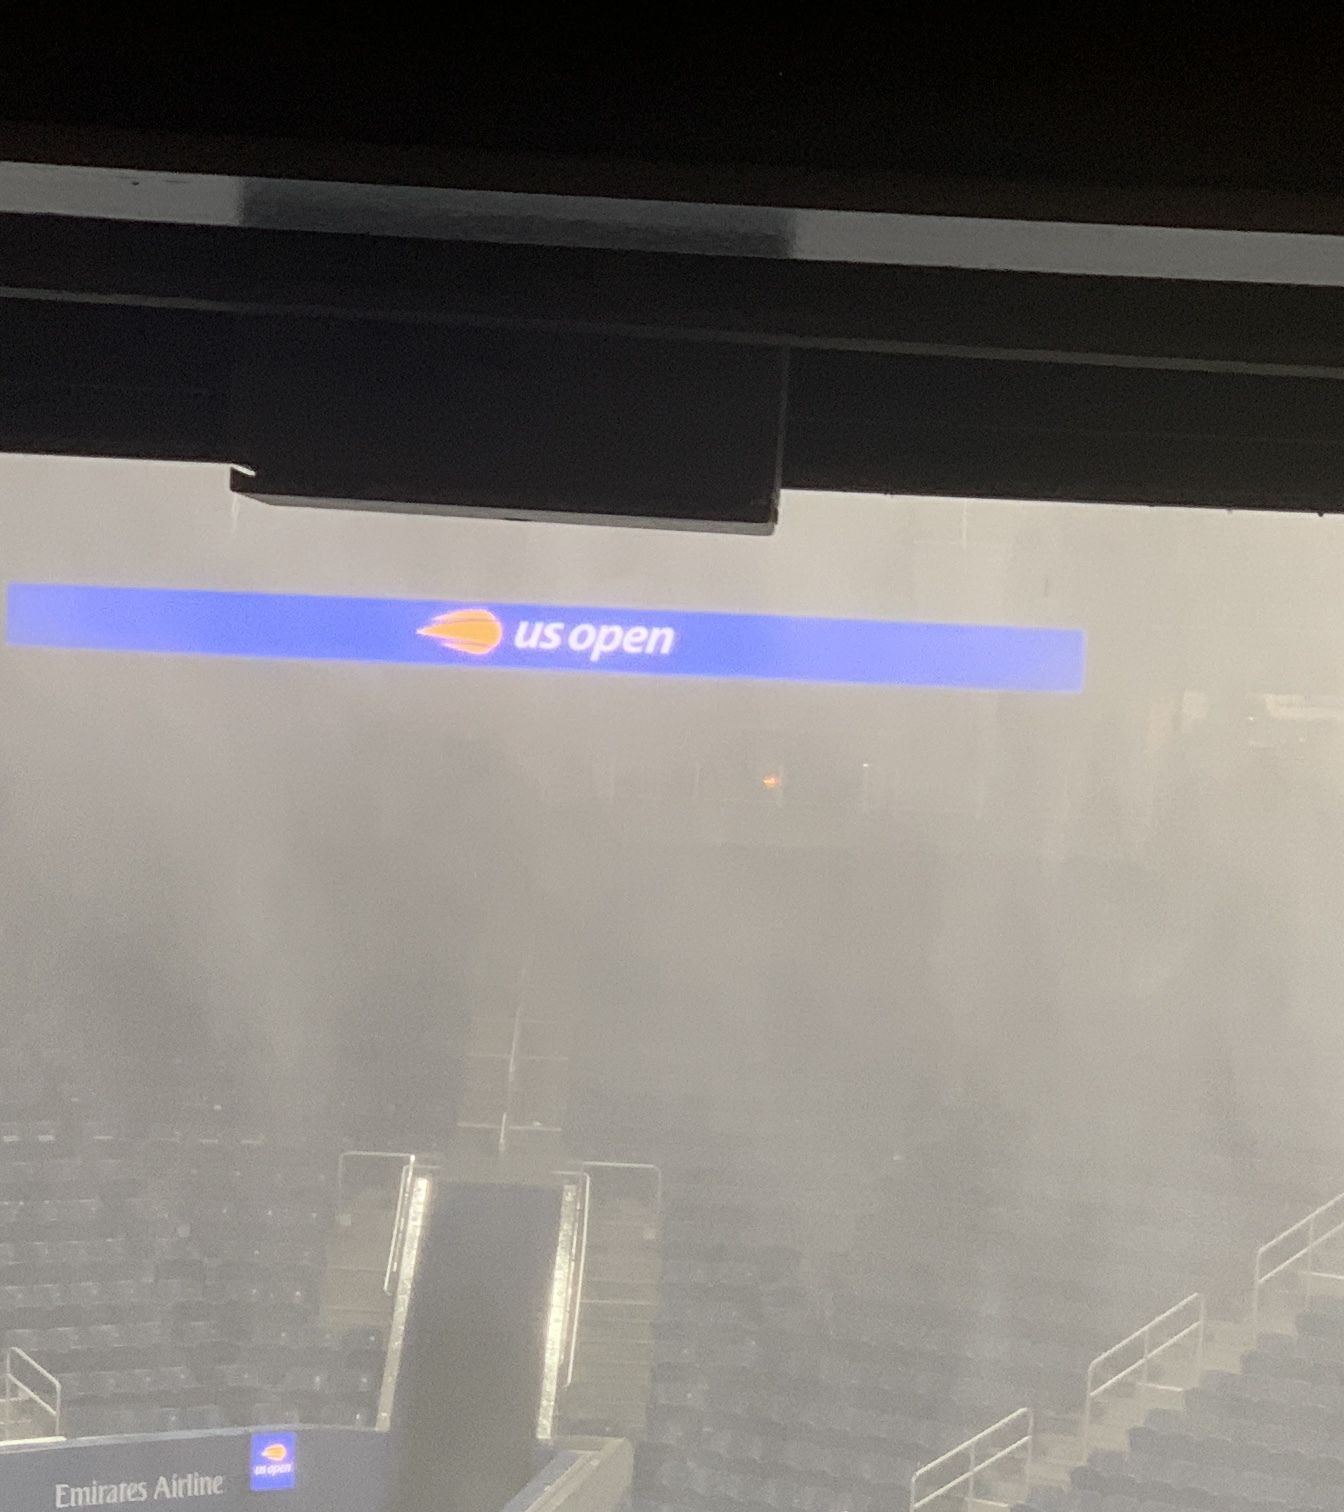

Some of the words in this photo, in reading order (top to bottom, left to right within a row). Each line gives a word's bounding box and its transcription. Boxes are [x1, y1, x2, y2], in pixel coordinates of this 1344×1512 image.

[514, 620, 564, 649] us
[568, 623, 675, 662] open
[56, 1481, 147, 1508] Emirates
[154, 1472, 224, 1499] Airline
